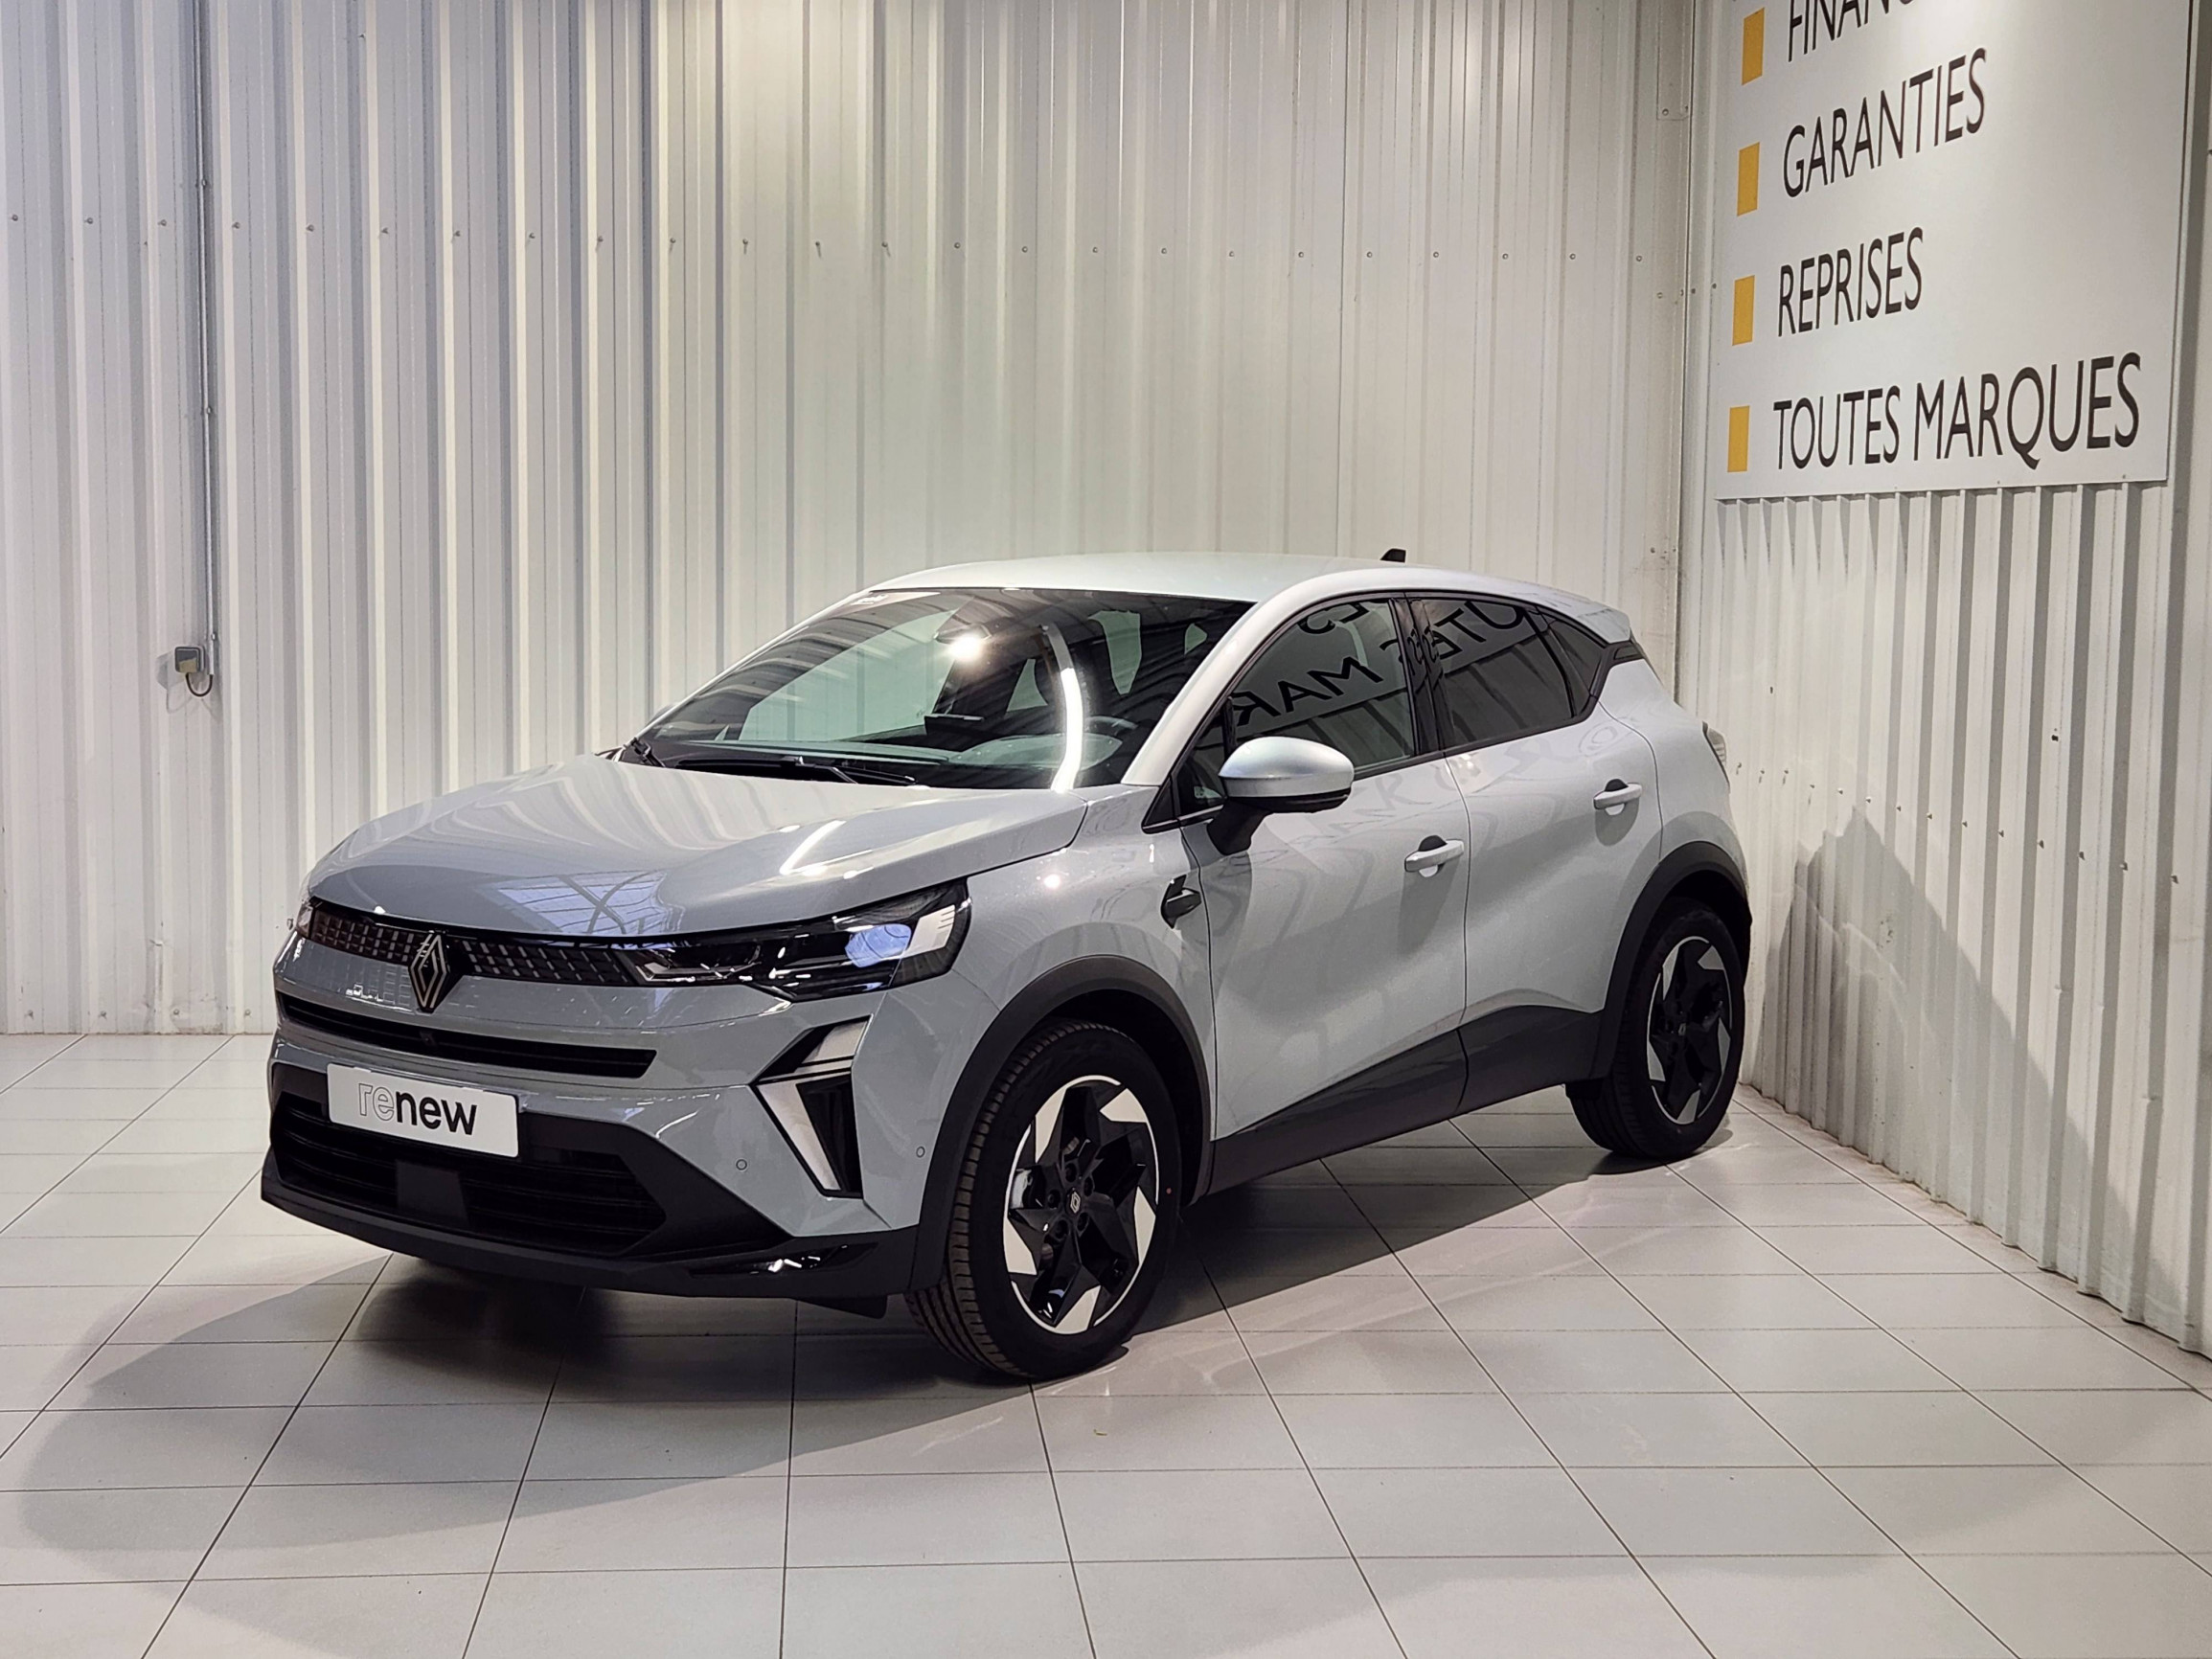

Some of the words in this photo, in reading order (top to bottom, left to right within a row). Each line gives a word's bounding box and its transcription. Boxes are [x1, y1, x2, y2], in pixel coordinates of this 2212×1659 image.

[1789, 0, 1914, 62] FINA
[1783, 47, 1987, 197] GARANTIES
[1777, 226, 1924, 337] REPRISES
[1773, 384, 1901, 469] TOUTES
[1913, 352, 2141, 470] MARQUES
[358, 1082, 478, 1136] renew
